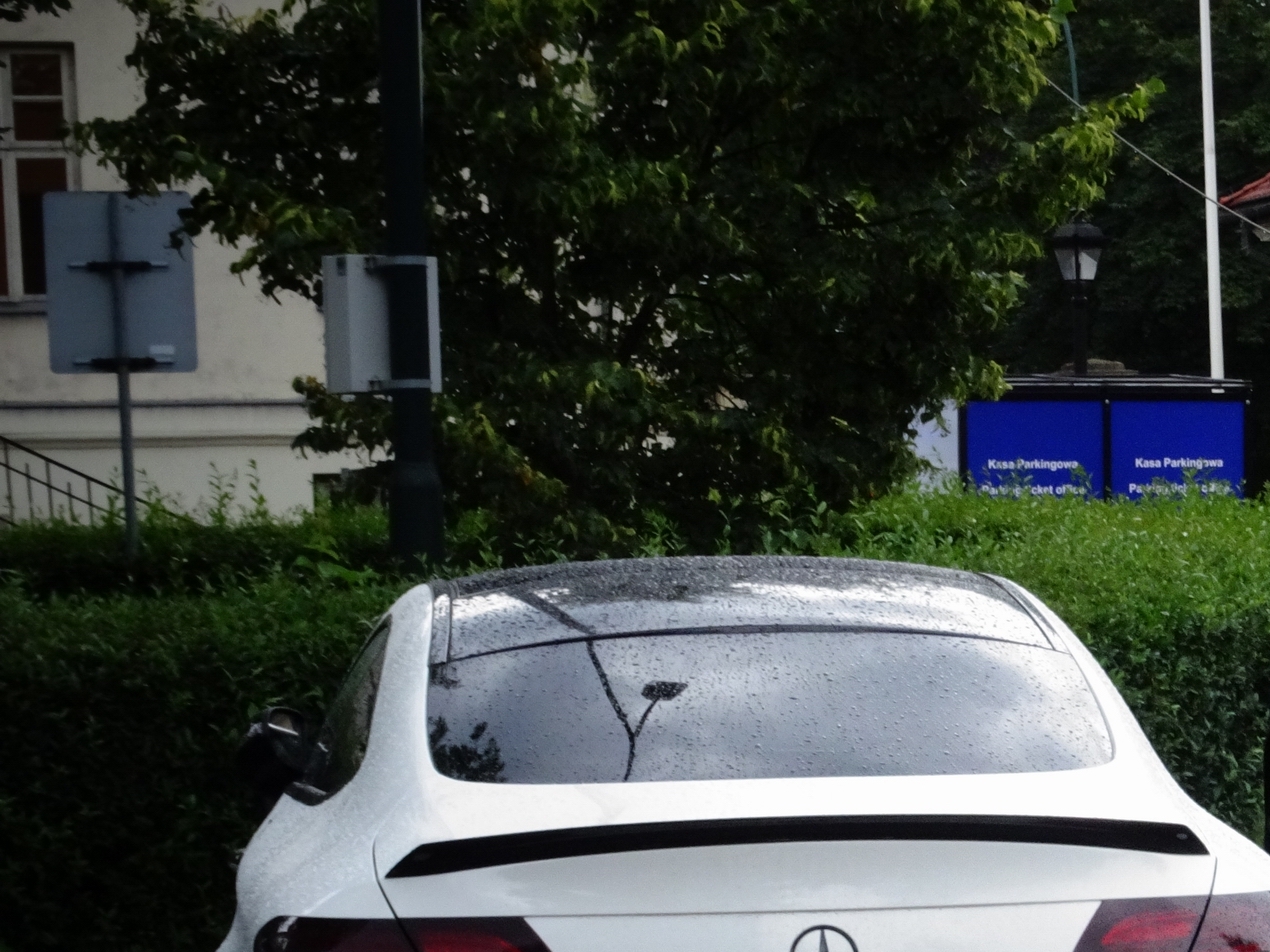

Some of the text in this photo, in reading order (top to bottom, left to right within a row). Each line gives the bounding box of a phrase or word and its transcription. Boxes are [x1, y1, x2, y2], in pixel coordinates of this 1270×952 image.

[1017, 459, 1079, 472] Parkingowa
[1135, 458, 1224, 470] Kasa Parkingowa
[981, 485, 1022, 497] Parkg
[1025, 485, 1053, 495] cket
[1129, 483, 1169, 495] Paking
